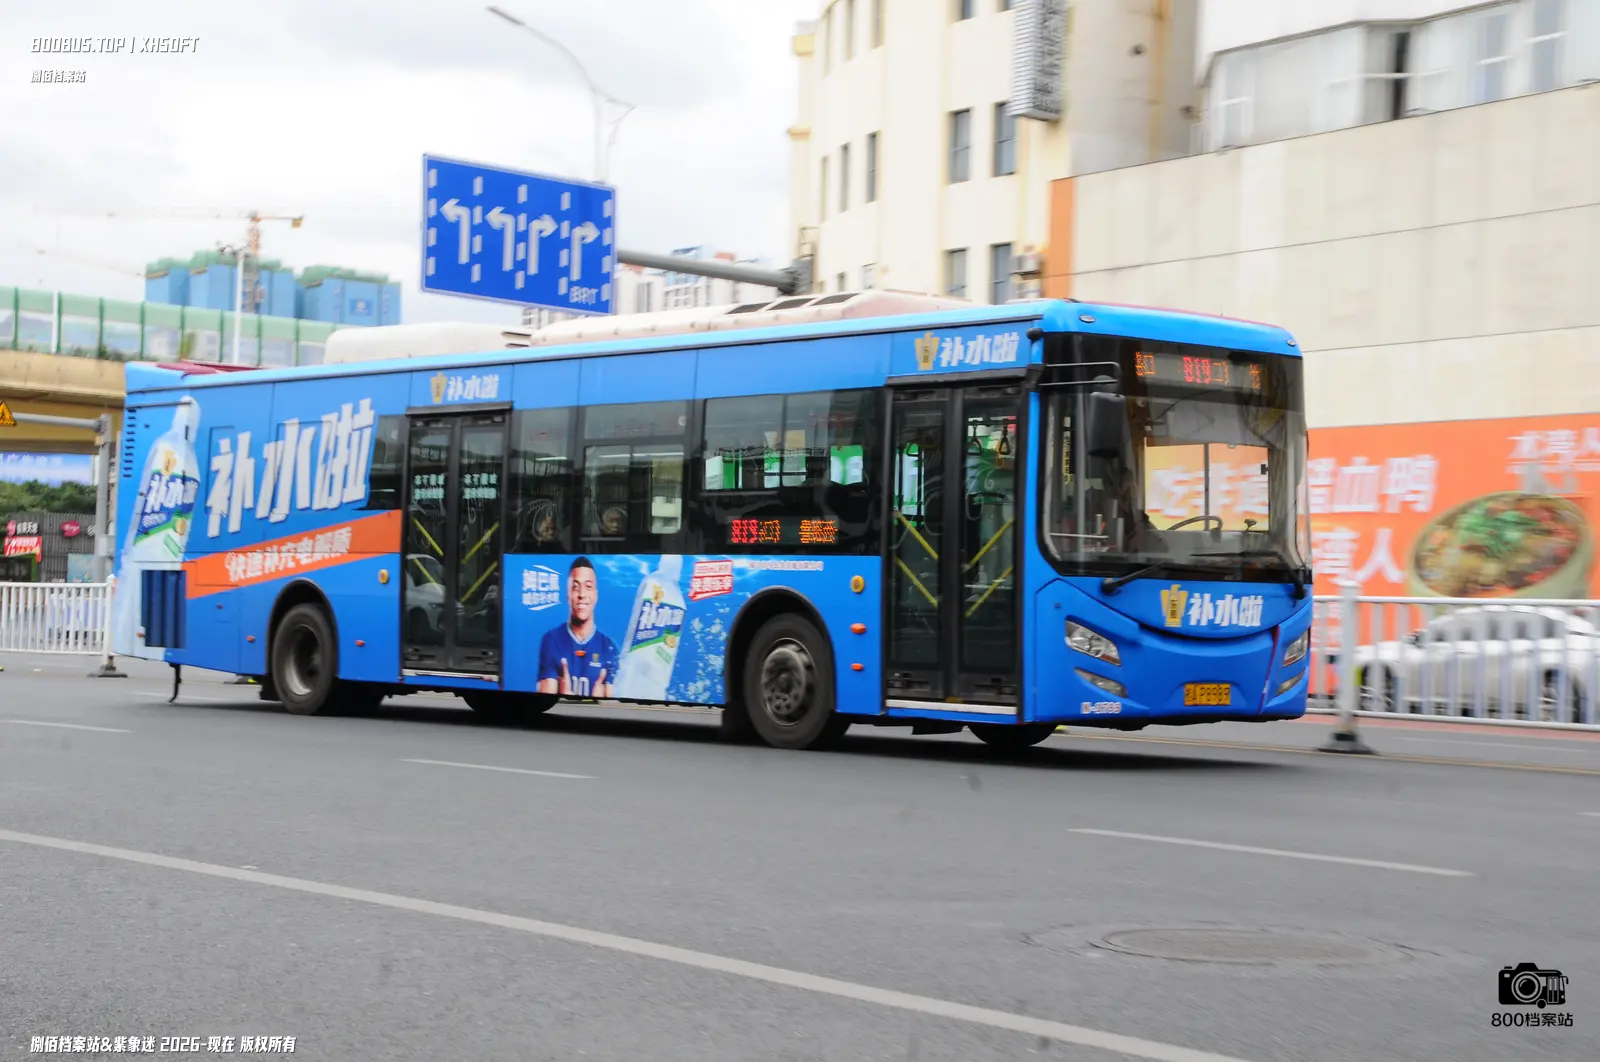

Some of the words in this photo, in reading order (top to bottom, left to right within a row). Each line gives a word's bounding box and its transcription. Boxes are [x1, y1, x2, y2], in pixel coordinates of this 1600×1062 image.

[940, 331, 1019, 367] 补水啦
[206, 397, 375, 539] 补水啦
[224, 526, 352, 582] 快速补充电解质
[1188, 593, 1264, 627] 补水啦
